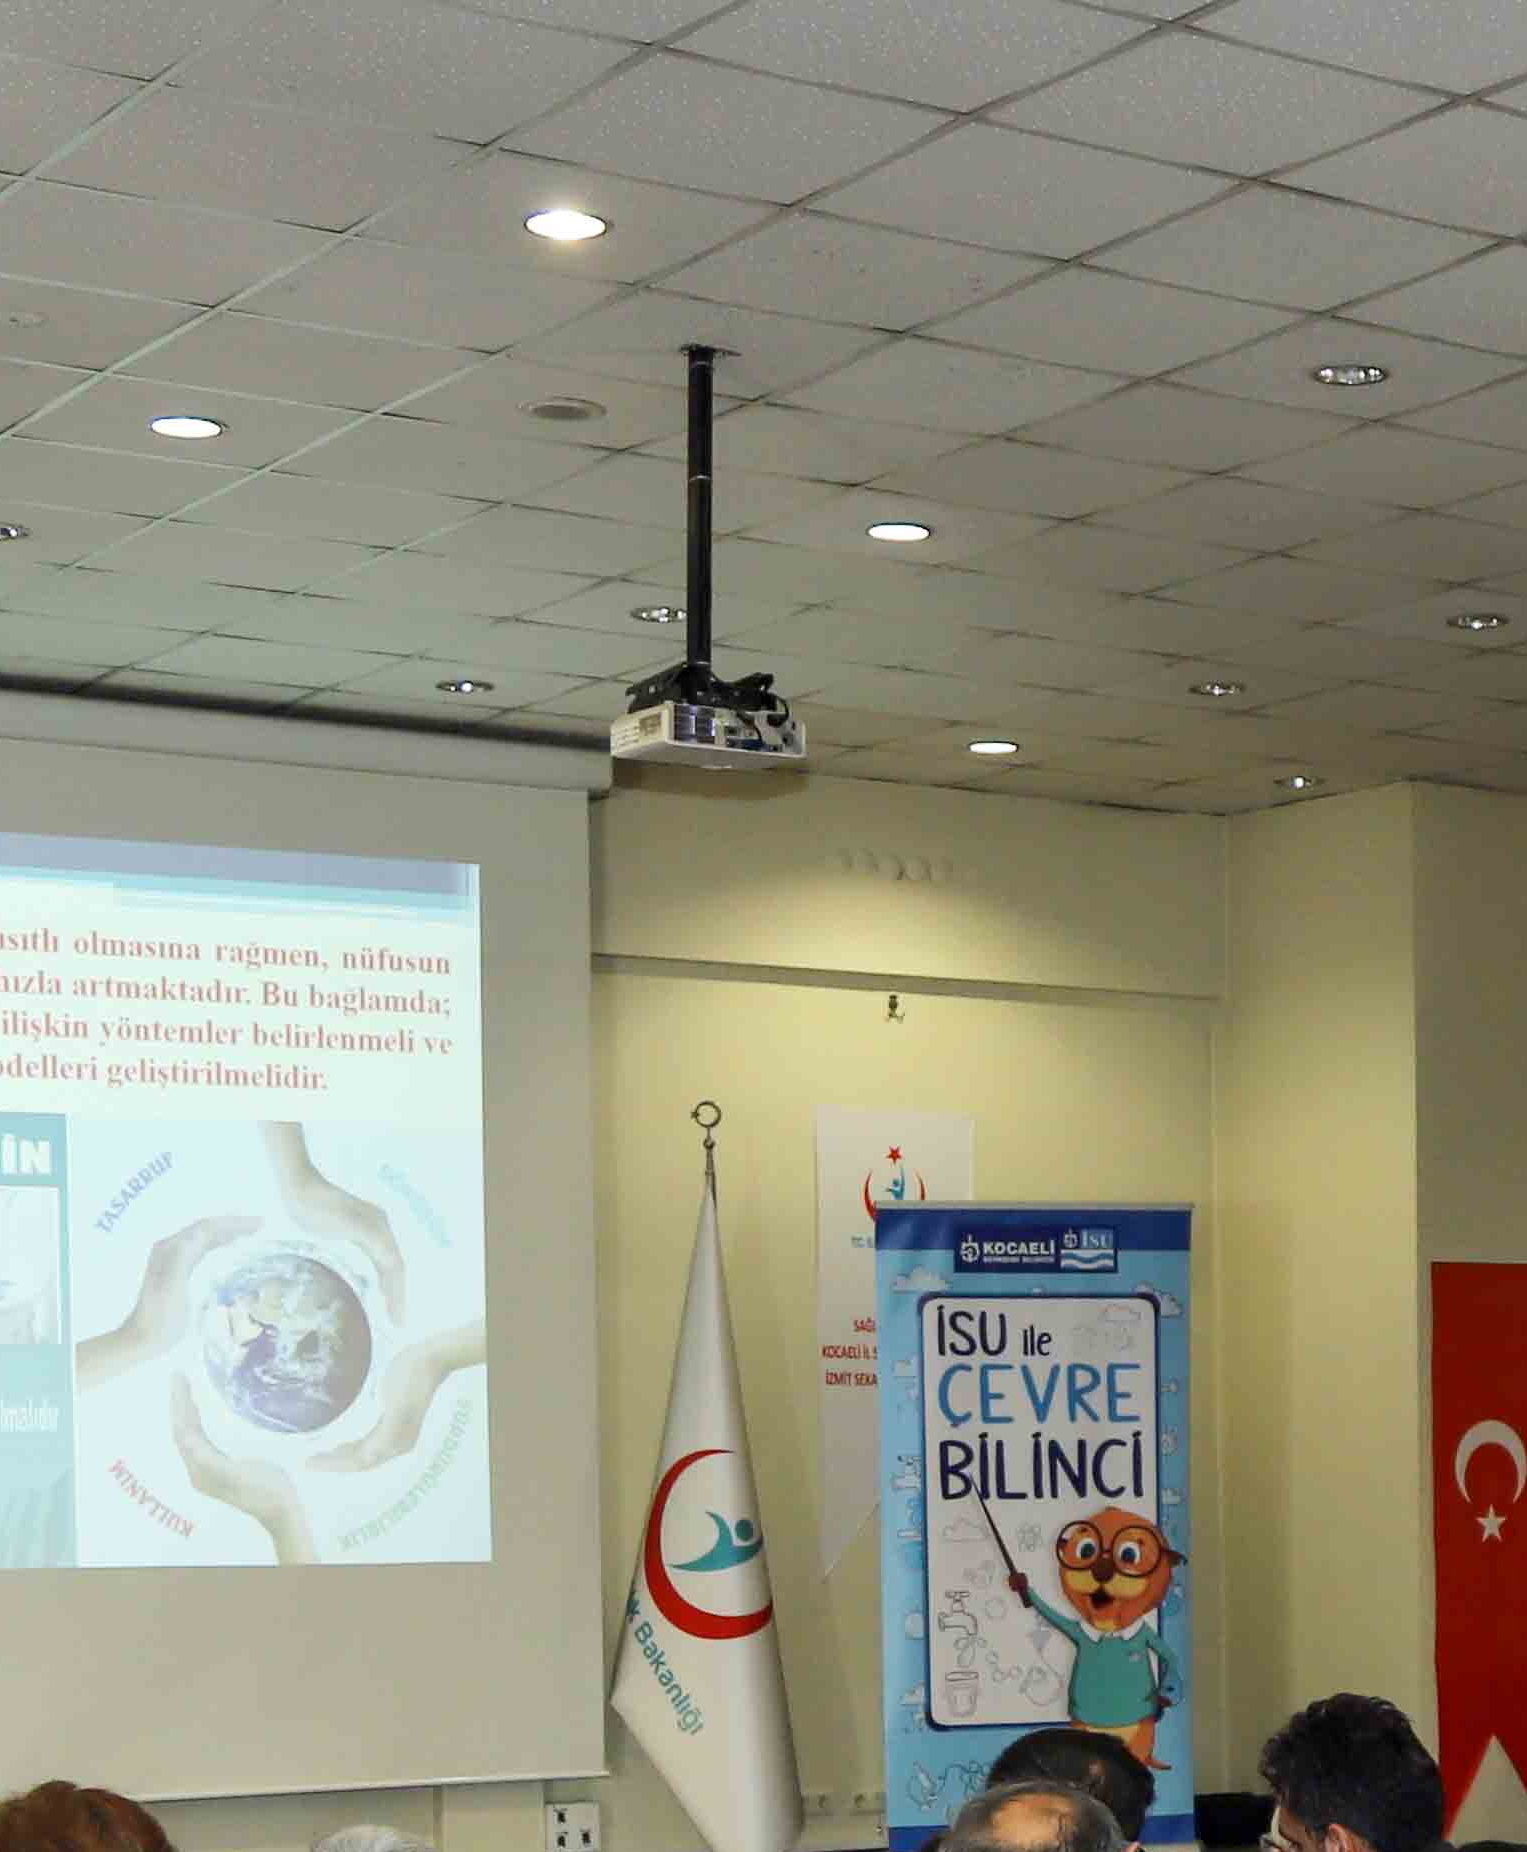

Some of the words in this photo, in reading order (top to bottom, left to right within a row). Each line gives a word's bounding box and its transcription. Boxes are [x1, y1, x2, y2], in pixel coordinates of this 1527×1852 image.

[73, 930, 201, 962] olmasına
[215, 938, 330, 970] rağmen,
[342, 947, 452, 977] nüfusun
[72, 974, 252, 1006] artmaktadır.
[262, 981, 299, 1009] Bu
[309, 984, 451, 1018] bağlamda;
[1, 1009, 90, 1043] ilişkin
[100, 1017, 243, 1048] yöntemler
[252, 1022, 415, 1055] belirlenmeli
[424, 1035, 454, 1056] ve
[107, 1057, 329, 1091] geliştirilmelidir.
[938, 1362, 1142, 1428] ÇEVRE
[939, 1430, 1144, 1500] BİLİNCİ
[634, 1620, 704, 1736] Bakanlığı
